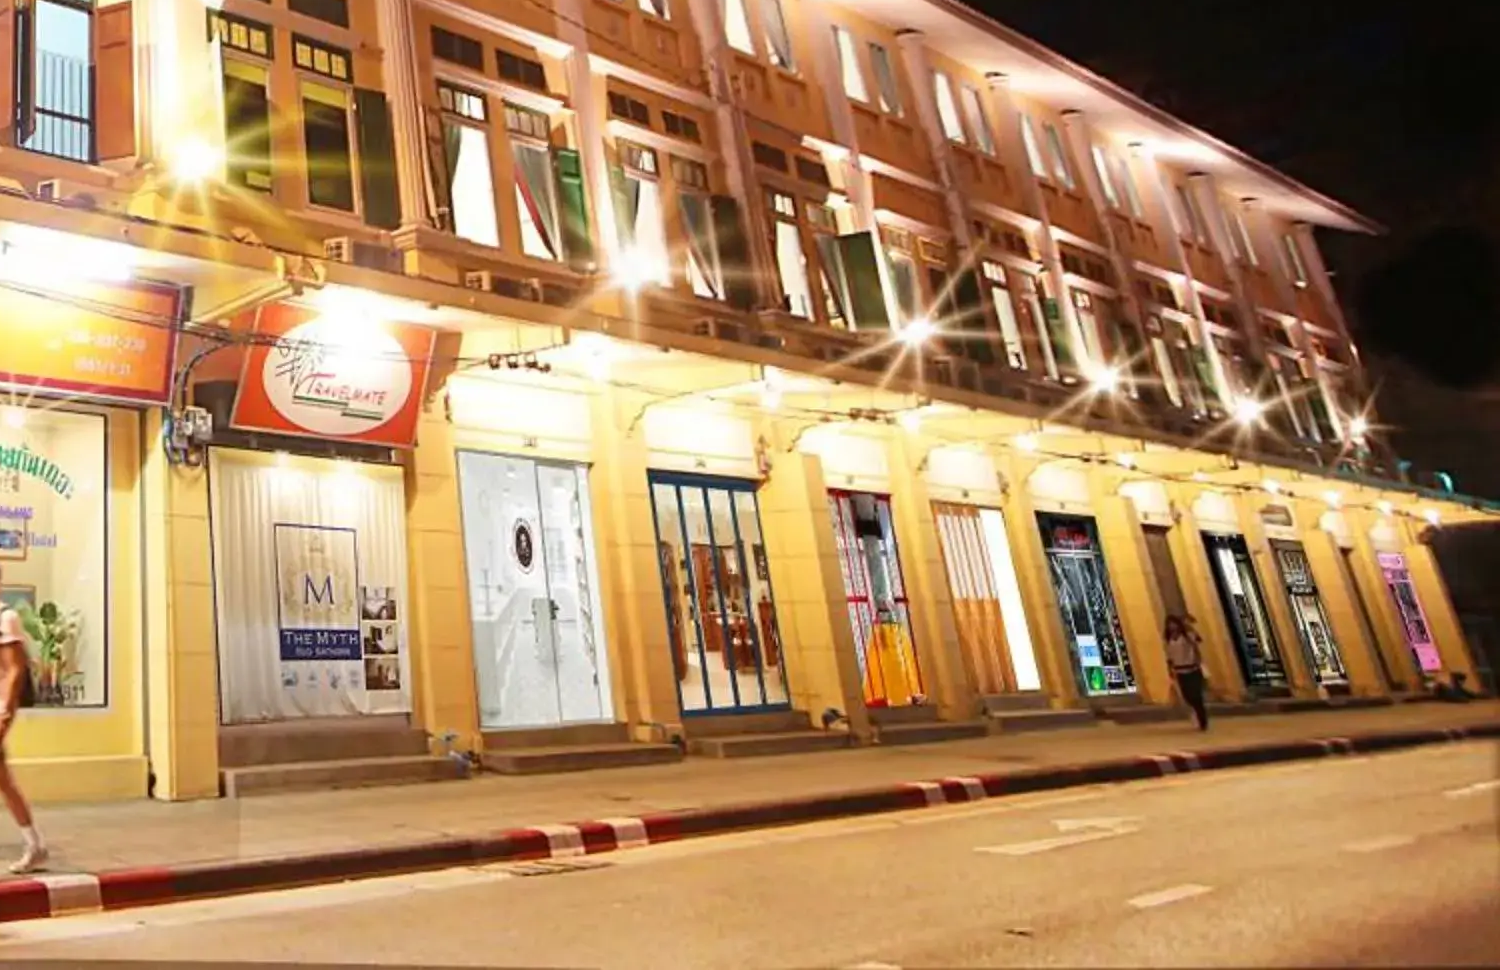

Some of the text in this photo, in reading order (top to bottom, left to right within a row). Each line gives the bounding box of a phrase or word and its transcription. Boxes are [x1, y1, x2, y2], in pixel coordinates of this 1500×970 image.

[300, 373, 387, 407] TRAVELMATE
[304, 573, 335, 605] M
[284, 631, 358, 645] THE MYTH
